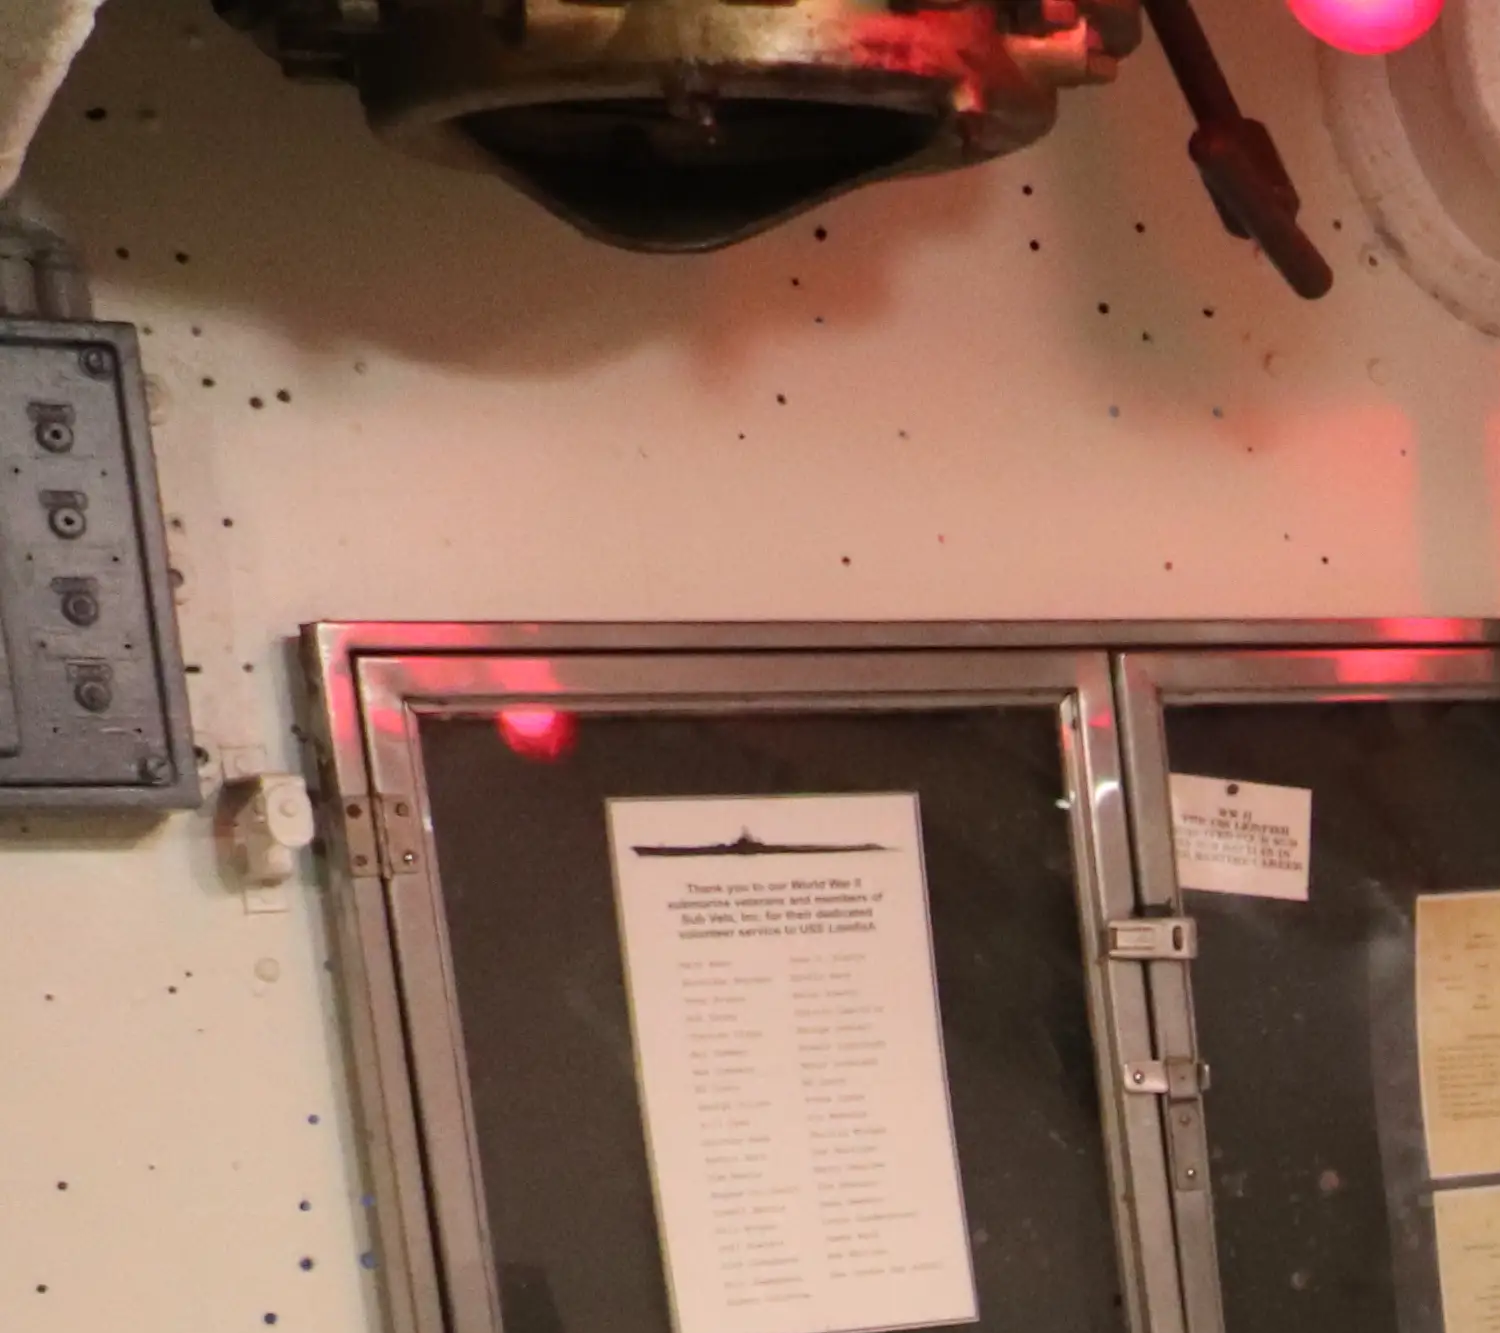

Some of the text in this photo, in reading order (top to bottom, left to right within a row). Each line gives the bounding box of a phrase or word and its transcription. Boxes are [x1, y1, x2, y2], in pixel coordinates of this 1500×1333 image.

[687, 883, 722, 893] Thank
[727, 884, 748, 895] you
[753, 882, 764, 891] to
[791, 879, 825, 889] World
[829, 879, 850, 888] War
